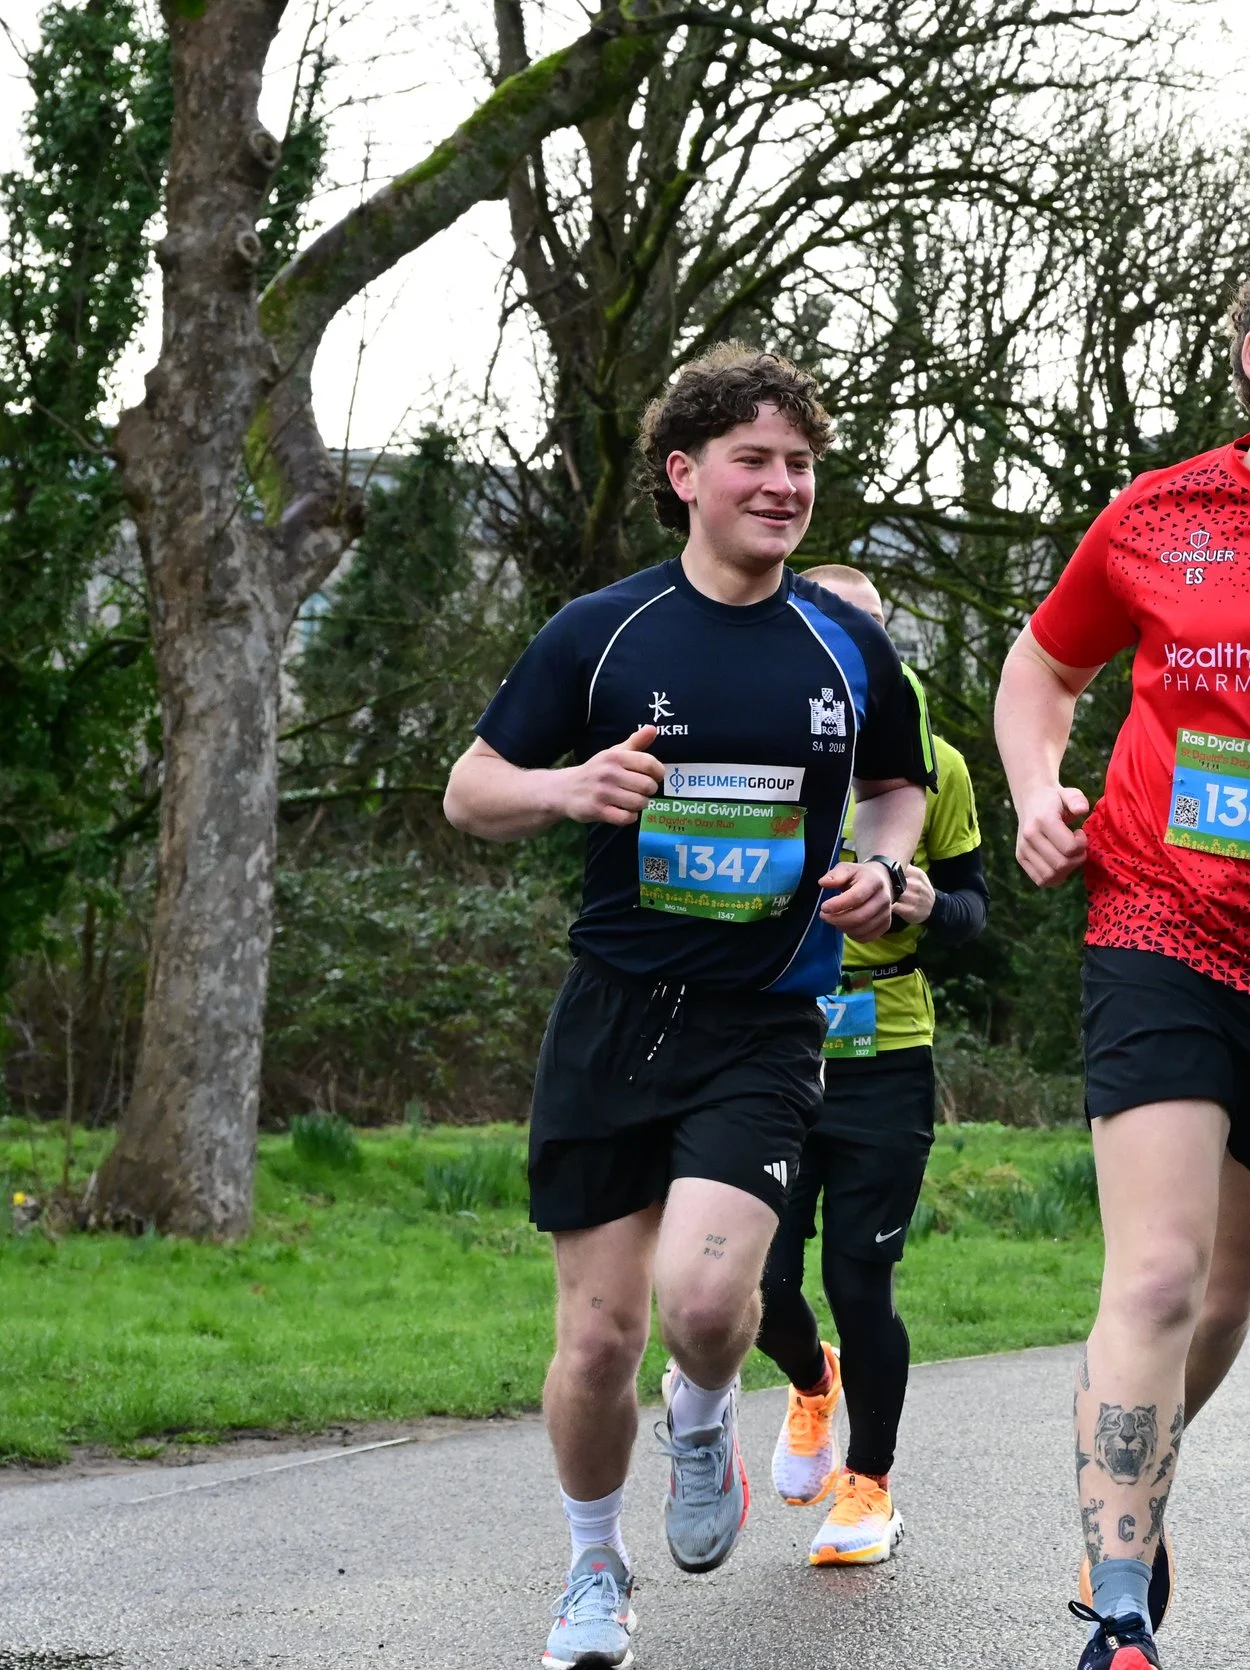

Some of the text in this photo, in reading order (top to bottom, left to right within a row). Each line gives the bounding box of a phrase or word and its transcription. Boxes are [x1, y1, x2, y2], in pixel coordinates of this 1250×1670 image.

[1160, 549, 1234, 563] CONQUER
[1186, 568, 1204, 584] ES
[812, 741, 846, 753] SA 2018
[1181, 730, 1205, 745] Ras
[1207, 735, 1244, 752] Dydd
[648, 800, 774, 818] Ras Dydd Gŵyl Dewi
[694, 819, 714, 828] Day
[716, 820, 735, 829] Run
[675, 844, 770, 884] 1347
[717, 911, 735, 920] 1347
[872, 965, 898, 977] UUB
[817, 1002, 847, 1029] 7
[853, 1036, 872, 1047] HM
[1117, 1514, 1136, 1542] C
